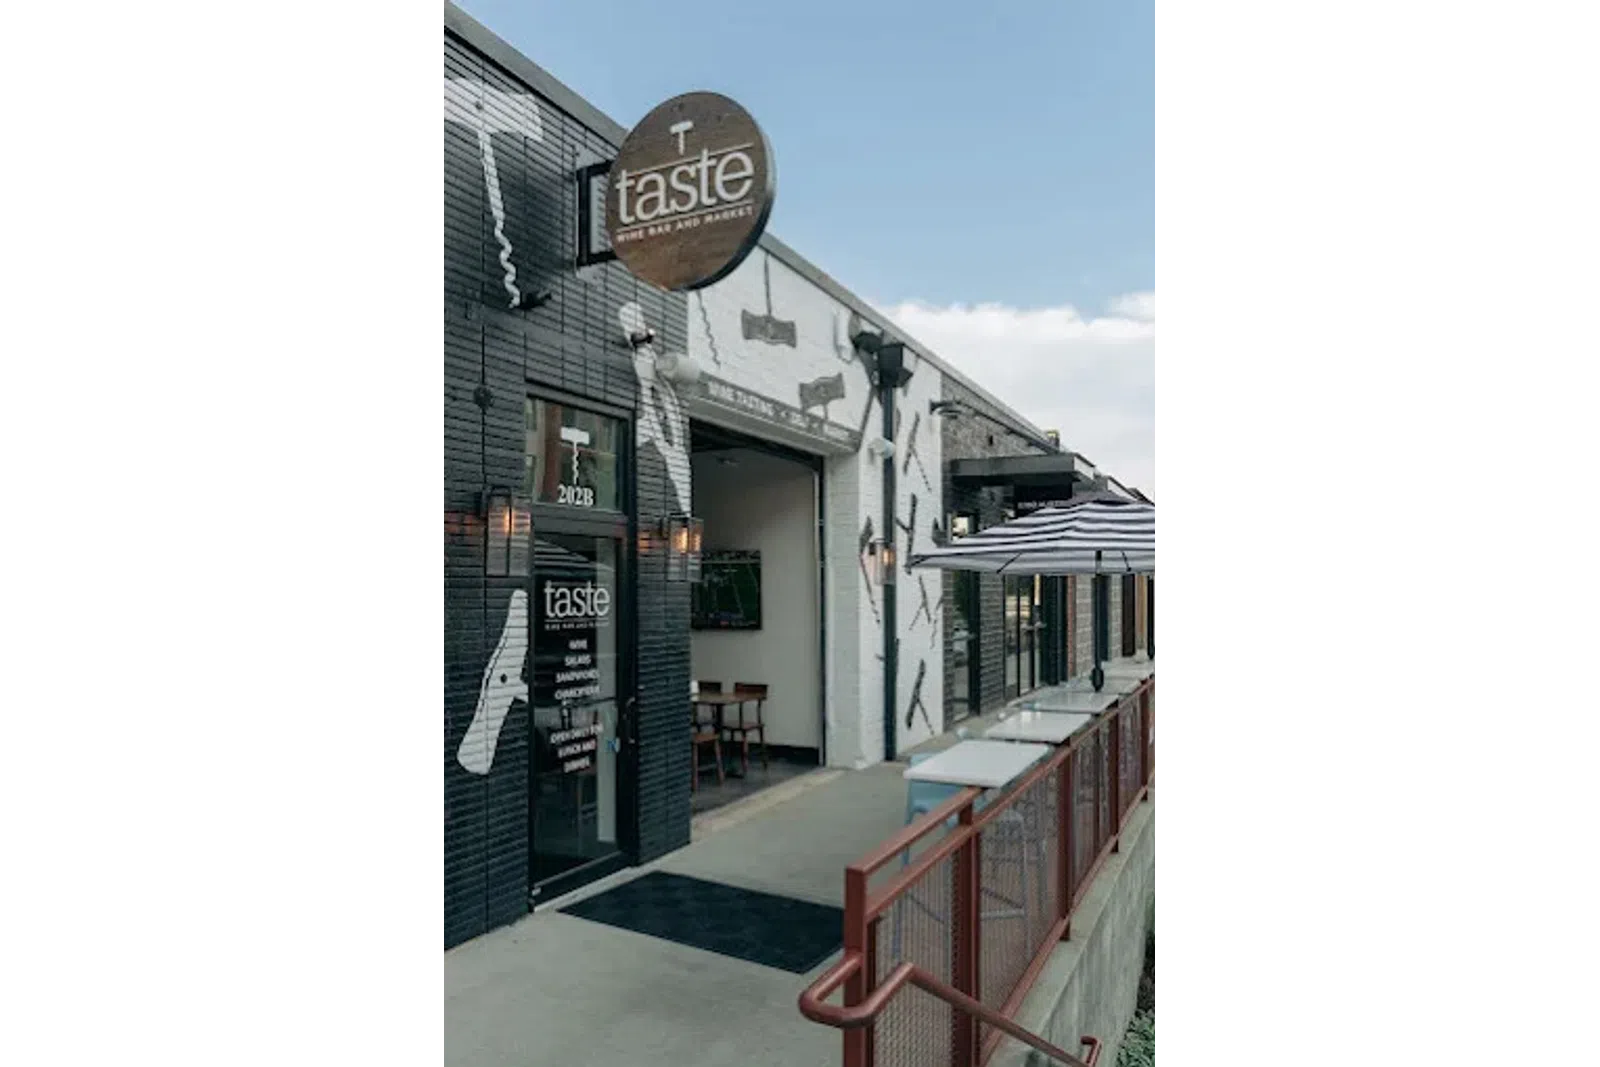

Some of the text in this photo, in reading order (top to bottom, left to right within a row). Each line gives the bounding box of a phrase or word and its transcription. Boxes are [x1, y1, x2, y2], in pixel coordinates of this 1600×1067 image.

[615, 149, 754, 224] taste
[616, 206, 753, 243] WINE BAR AND MARKET
[557, 483, 595, 507] 202B
[543, 580, 610, 617] taste
